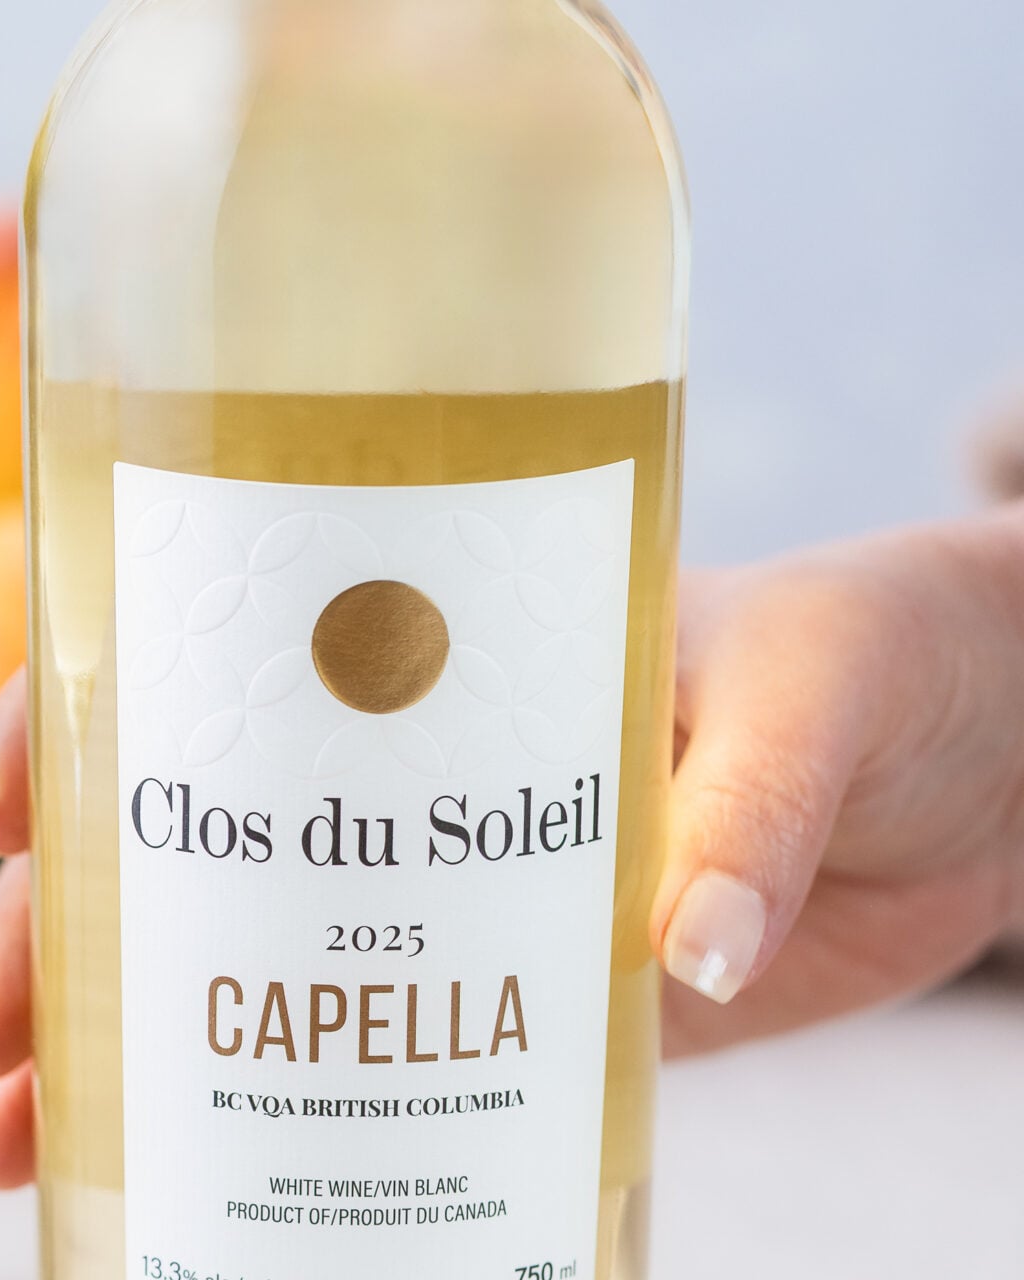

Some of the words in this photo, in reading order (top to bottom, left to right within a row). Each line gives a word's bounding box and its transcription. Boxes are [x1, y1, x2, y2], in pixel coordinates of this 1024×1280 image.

[130, 777, 273, 863] Clos
[300, 796, 400, 867] du
[428, 772, 603, 866] Soleil
[325, 922, 425, 957] 2025
[207, 974, 529, 1064] CAPELLA
[212, 1089, 243, 1110] BC
[246, 1093, 297, 1118] VQA
[300, 1097, 401, 1118] BRITISH
[405, 1088, 525, 1117] COLUMBIA
[268, 1176, 324, 1197] WHITE
[327, 1179, 409, 1198] WINE/VIN
[414, 1175, 469, 1196] BLANC
[227, 1200, 305, 1224] PRODUCT
[308, 1207, 413, 1226] OF/PRODUIT
[416, 1205, 439, 1224] DU
[444, 1199, 507, 1222] CANADA
[559, 1259, 577, 1280] ml
